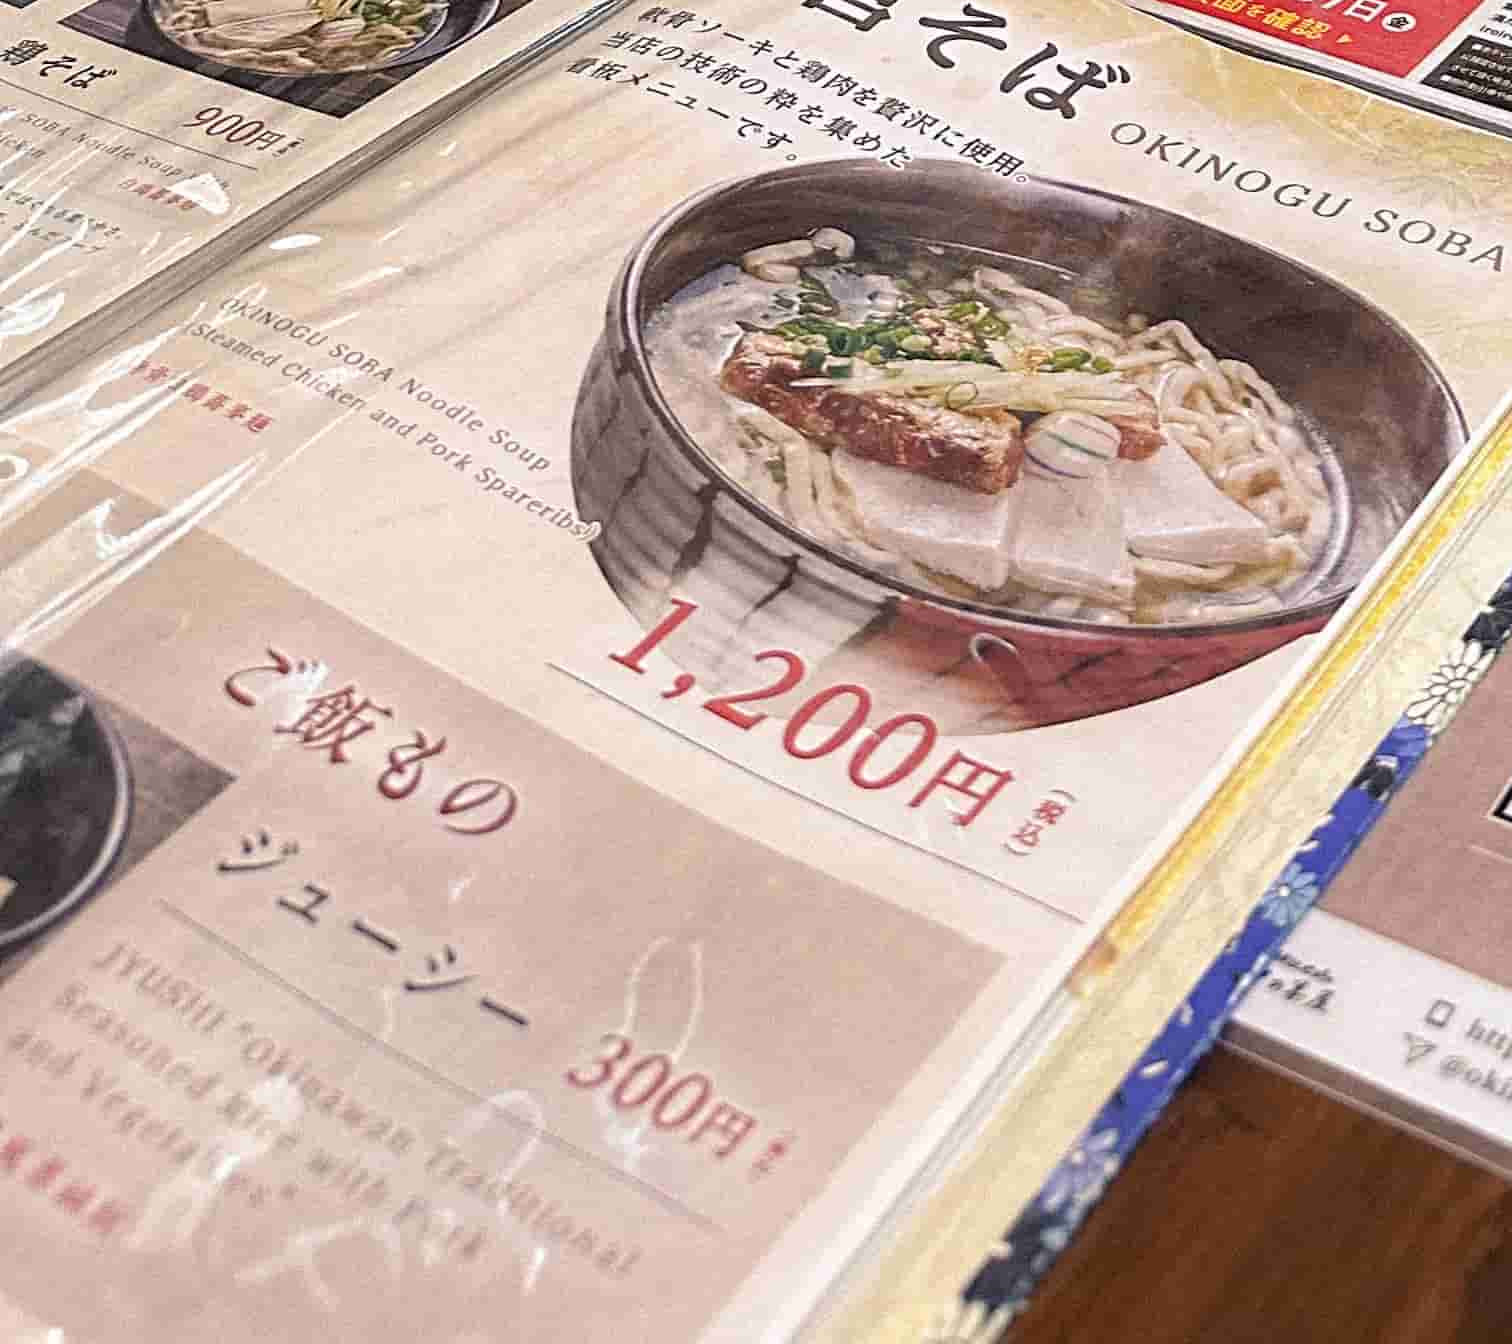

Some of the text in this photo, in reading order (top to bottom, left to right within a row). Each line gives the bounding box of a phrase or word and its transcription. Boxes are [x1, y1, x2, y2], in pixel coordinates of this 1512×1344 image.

[1109, 120, 1507, 273] OKINOGU SOBA
[281, 362, 367, 412] Chicken
[369, 406, 419, 440] and
[416, 431, 477, 473] Pork
[328, 342, 396, 383] SOBA
[399, 376, 485, 433] Noodle
[488, 426, 551, 474] Soup
[224, 646, 520, 835] ご飯もの
[609, 597, 1016, 827] 1,200円
[217, 828, 529, 1027] ジューシー
